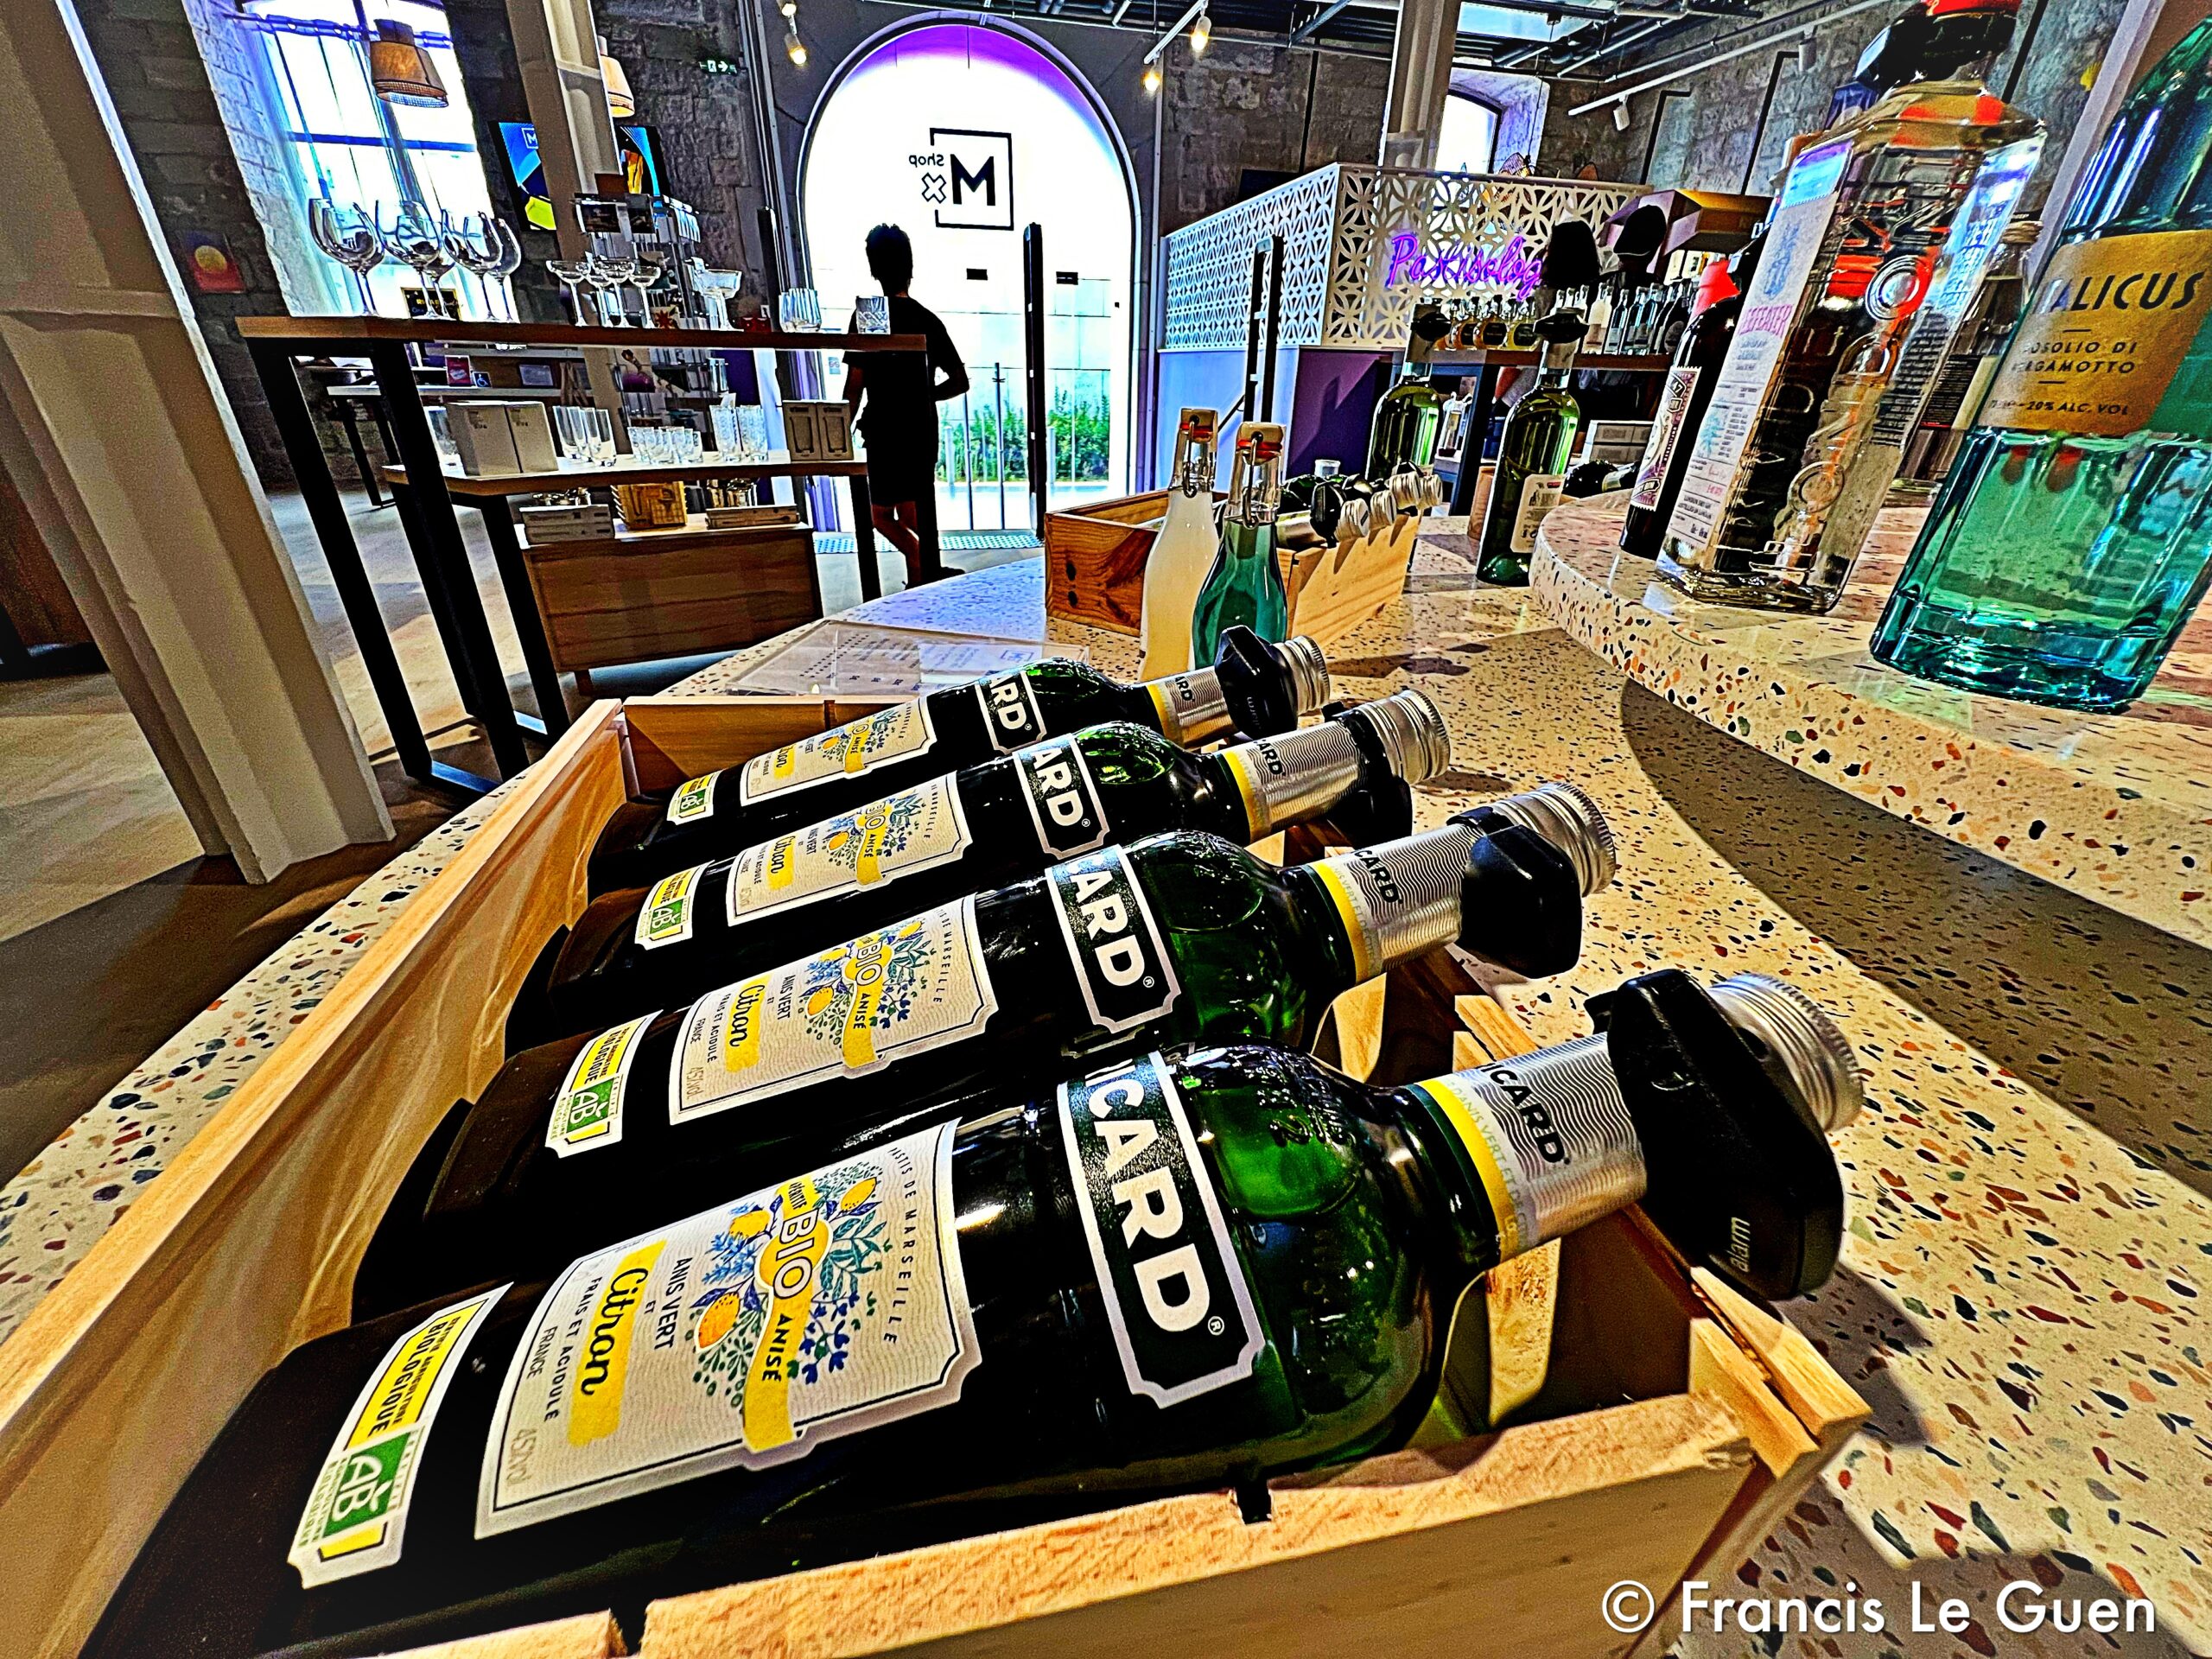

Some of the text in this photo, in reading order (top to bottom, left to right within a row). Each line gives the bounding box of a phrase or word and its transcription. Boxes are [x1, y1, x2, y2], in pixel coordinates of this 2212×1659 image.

[1388, 234, 1542, 301] Pastisolog
[2024, 341, 2138, 353] OSOLIO DI
[988, 675, 1027, 729] ARD
[1175, 676, 1193, 701] ARD
[1256, 741, 1284, 775] ARD
[1033, 748, 1084, 826] ARD
[1353, 849, 1401, 904] CARD
[1069, 869, 1146, 987] ARD
[855, 940, 883, 986] BIO
[729, 984, 766, 1047] Citron
[778, 996, 791, 1020] VERT
[569, 1091, 600, 1124] AB
[1478, 1062, 1566, 1164] ICARD
[904, 1180, 917, 1199] DE
[1085, 1058, 1211, 1332] ICARD
[773, 1209, 819, 1300] BIO
[883, 1209, 918, 1344] MARSEILLE
[574, 1276, 602, 1317] FRAIS
[644, 1300, 657, 1314] ET
[654, 1257, 695, 1351] ANIS VERT
[526, 1325, 558, 1381] FRANCE
[566, 1319, 583, 1338] ET
[580, 1267, 649, 1396] Citron
[367, 1320, 448, 1438] BIOLOGIQUE
[333, 1455, 383, 1522] AB
